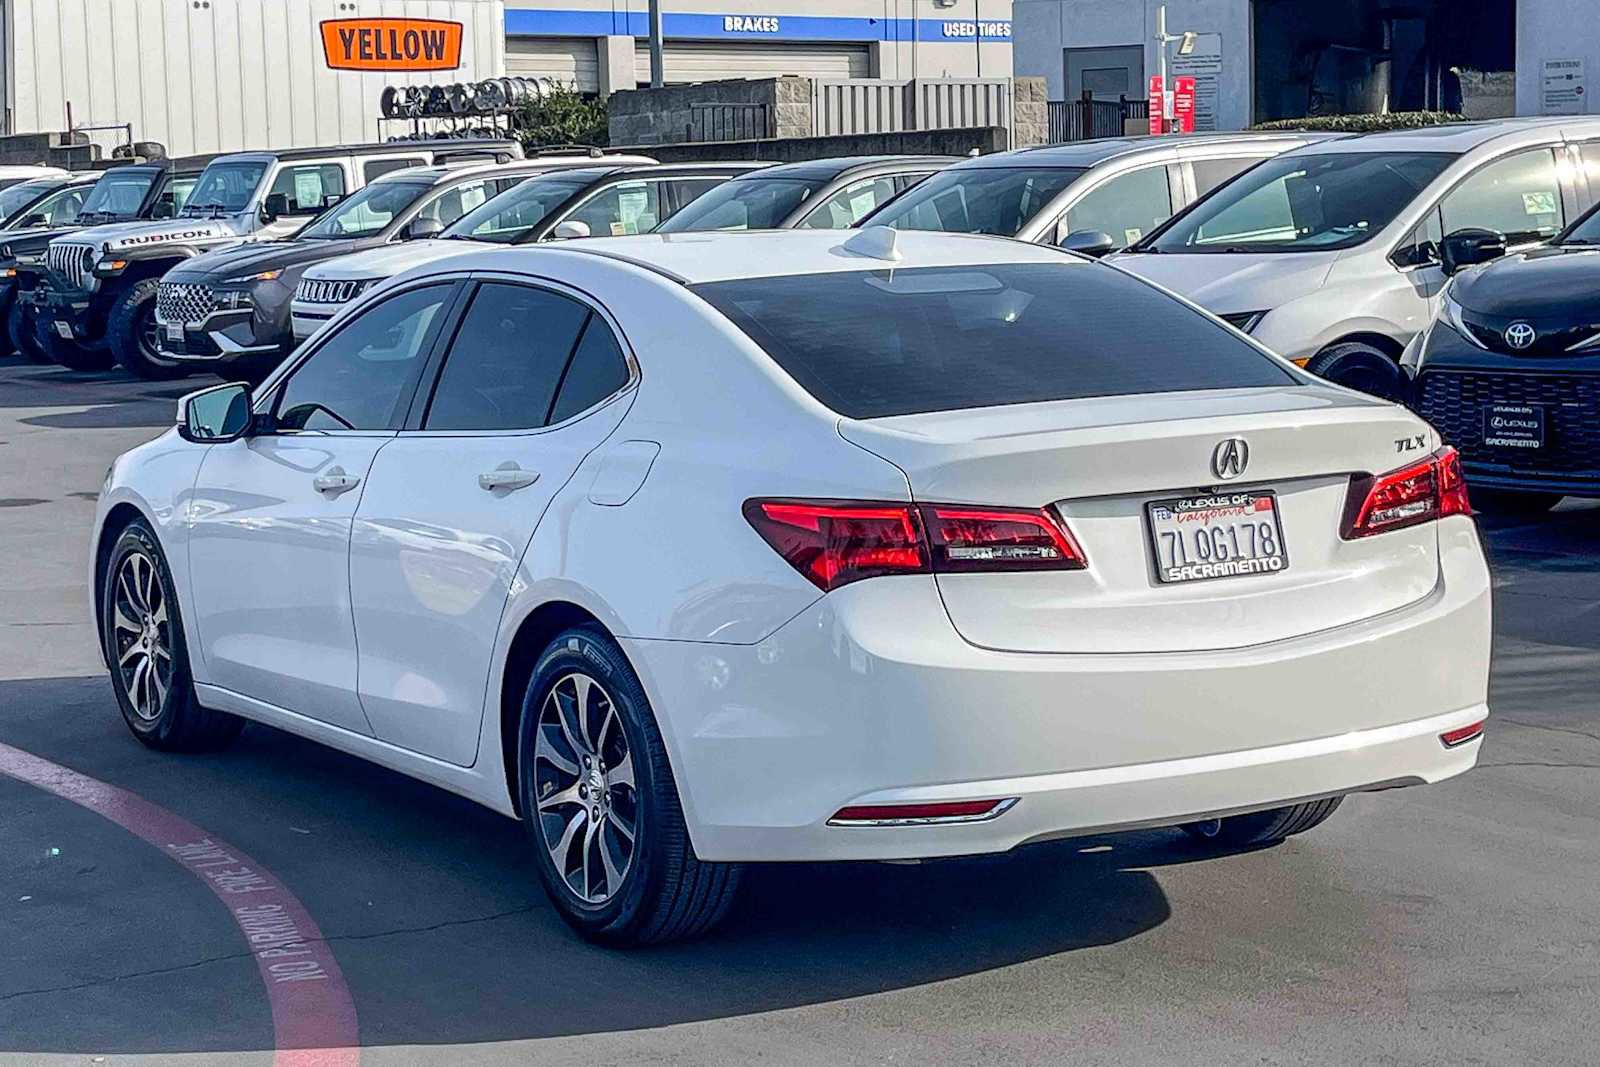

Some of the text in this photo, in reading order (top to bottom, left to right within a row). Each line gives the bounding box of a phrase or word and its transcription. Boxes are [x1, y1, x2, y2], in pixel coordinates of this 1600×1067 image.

[723, 16, 779, 33] BRAKES
[943, 22, 1012, 37] USED TIRES
[338, 28, 446, 61] YELLOW
[120, 229, 211, 246] RUBICON
[1504, 419, 1538, 428] LEXUS
[1394, 434, 1426, 453] TLX
[1485, 437, 1540, 448] SACRAMENTO
[1187, 497, 1230, 509] LEXUS
[1231, 494, 1249, 505] OF
[1168, 556, 1283, 581] SACRAMENTO
[204, 866, 277, 894] FIRE
[235, 903, 313, 959] PARKING
[268, 960, 329, 983] NO
